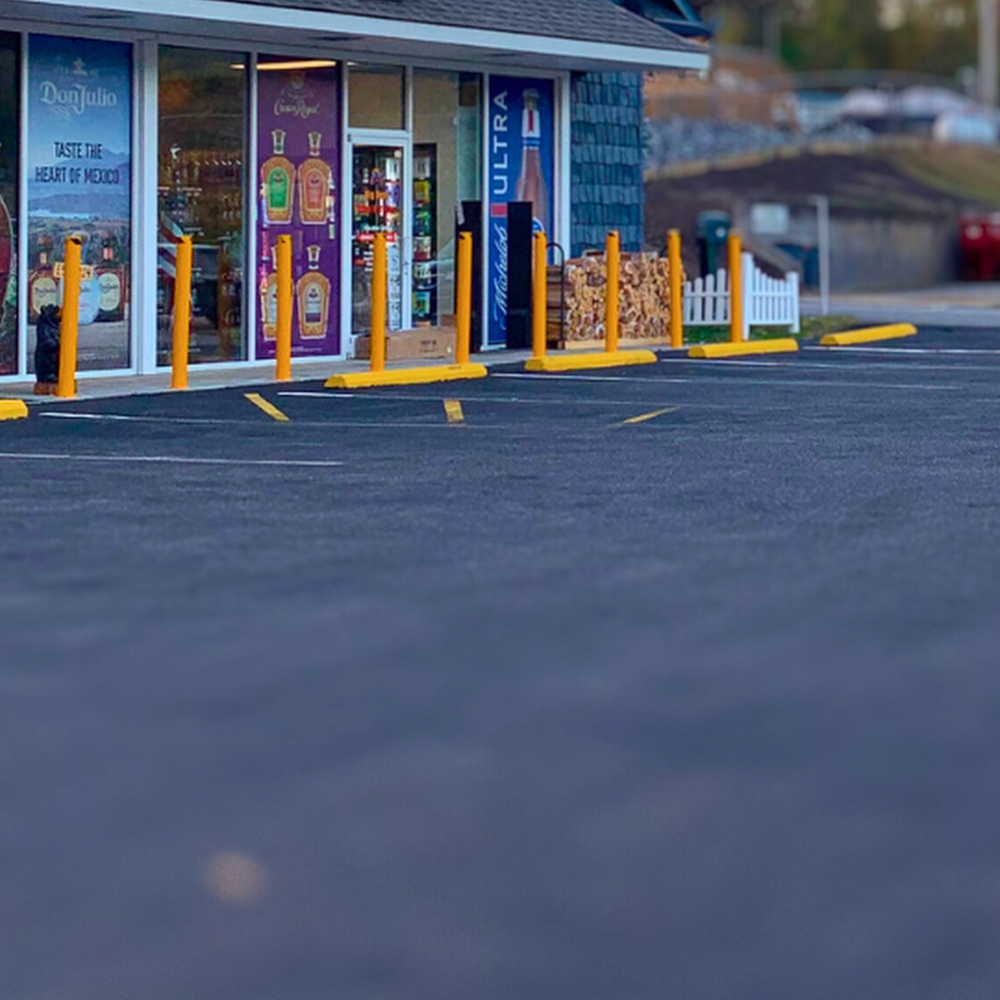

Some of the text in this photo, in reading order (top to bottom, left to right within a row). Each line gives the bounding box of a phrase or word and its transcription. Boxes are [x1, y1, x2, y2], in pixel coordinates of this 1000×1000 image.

[54, 142, 103, 159] TASTE THE
[493, 91, 508, 195] ULTRA
[35, 166, 119, 185] HEART OF MEXICO
